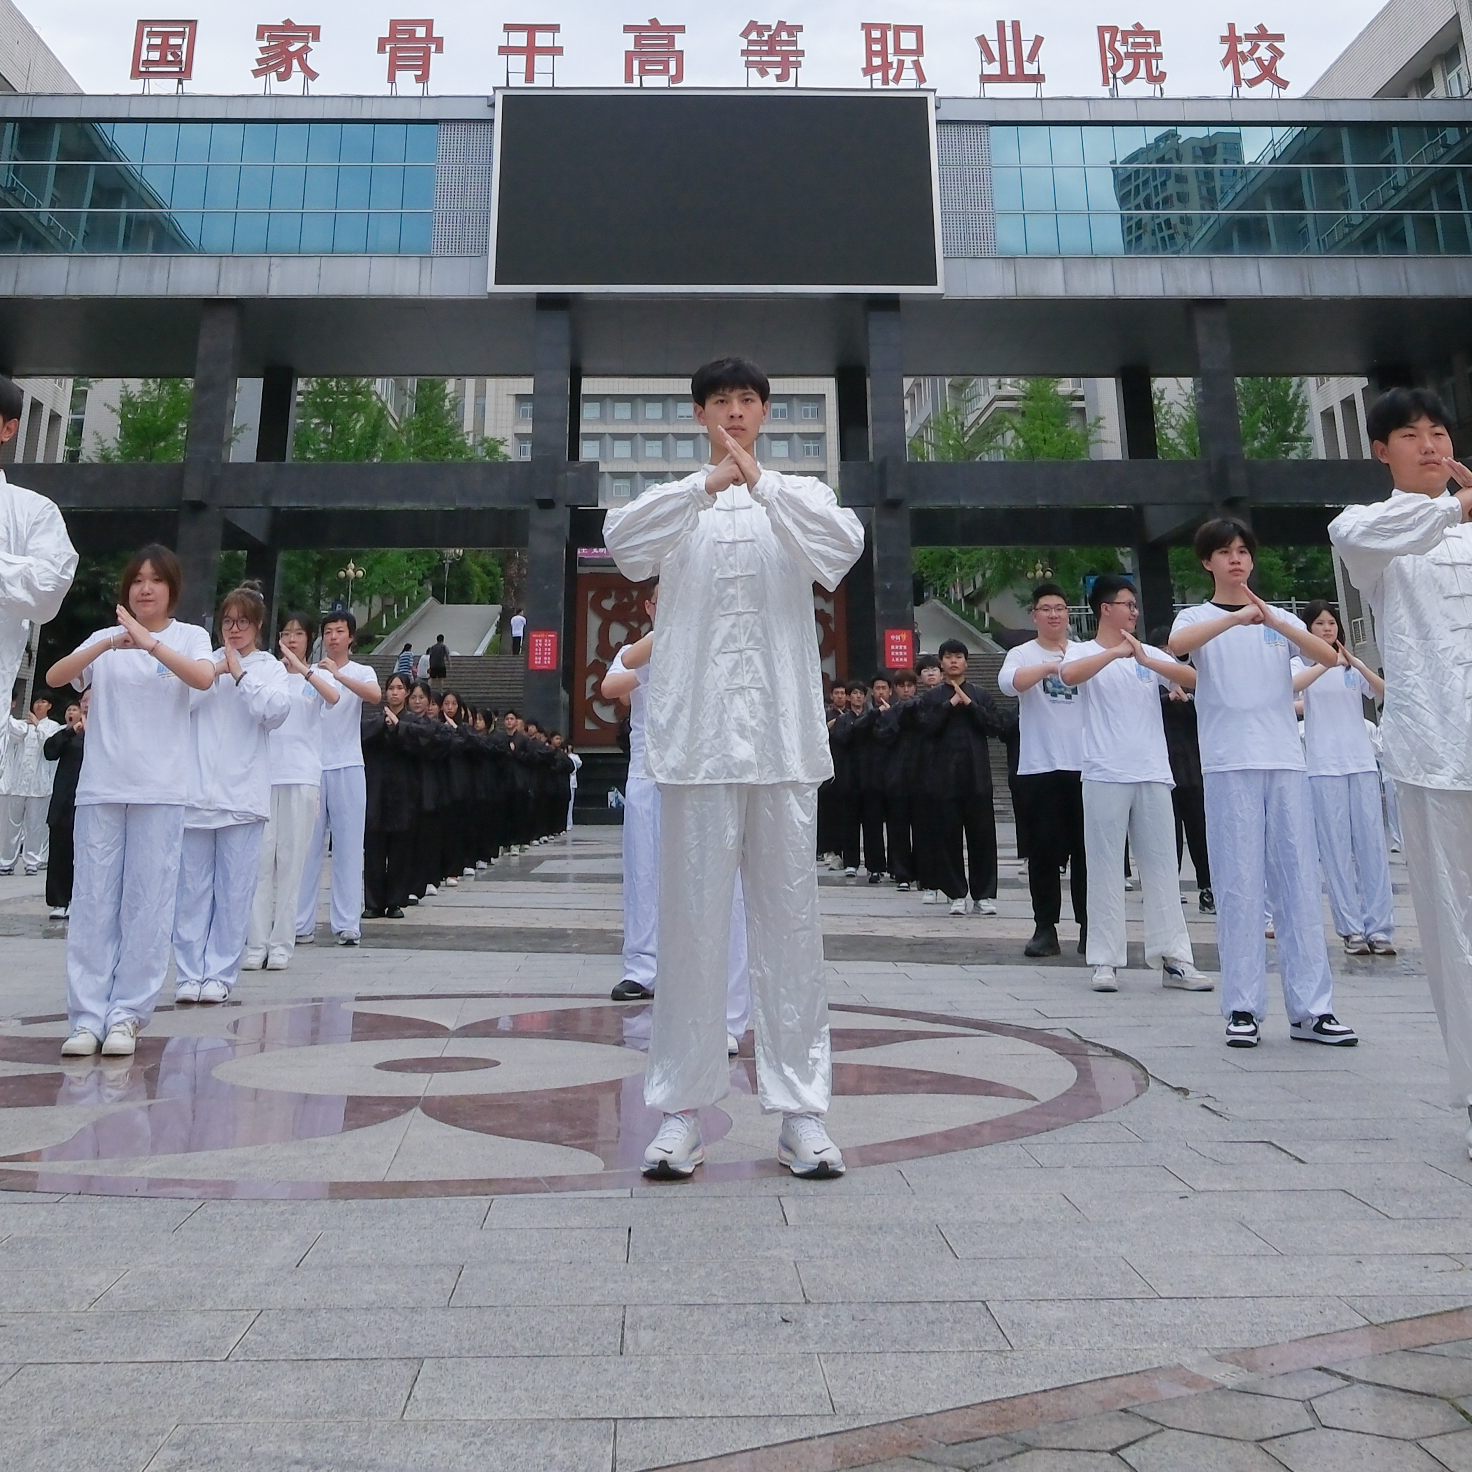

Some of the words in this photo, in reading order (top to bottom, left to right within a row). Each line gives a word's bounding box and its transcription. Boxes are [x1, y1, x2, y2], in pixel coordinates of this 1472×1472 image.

[129, 18, 1290, 90] 国家骨干高等职业院校
